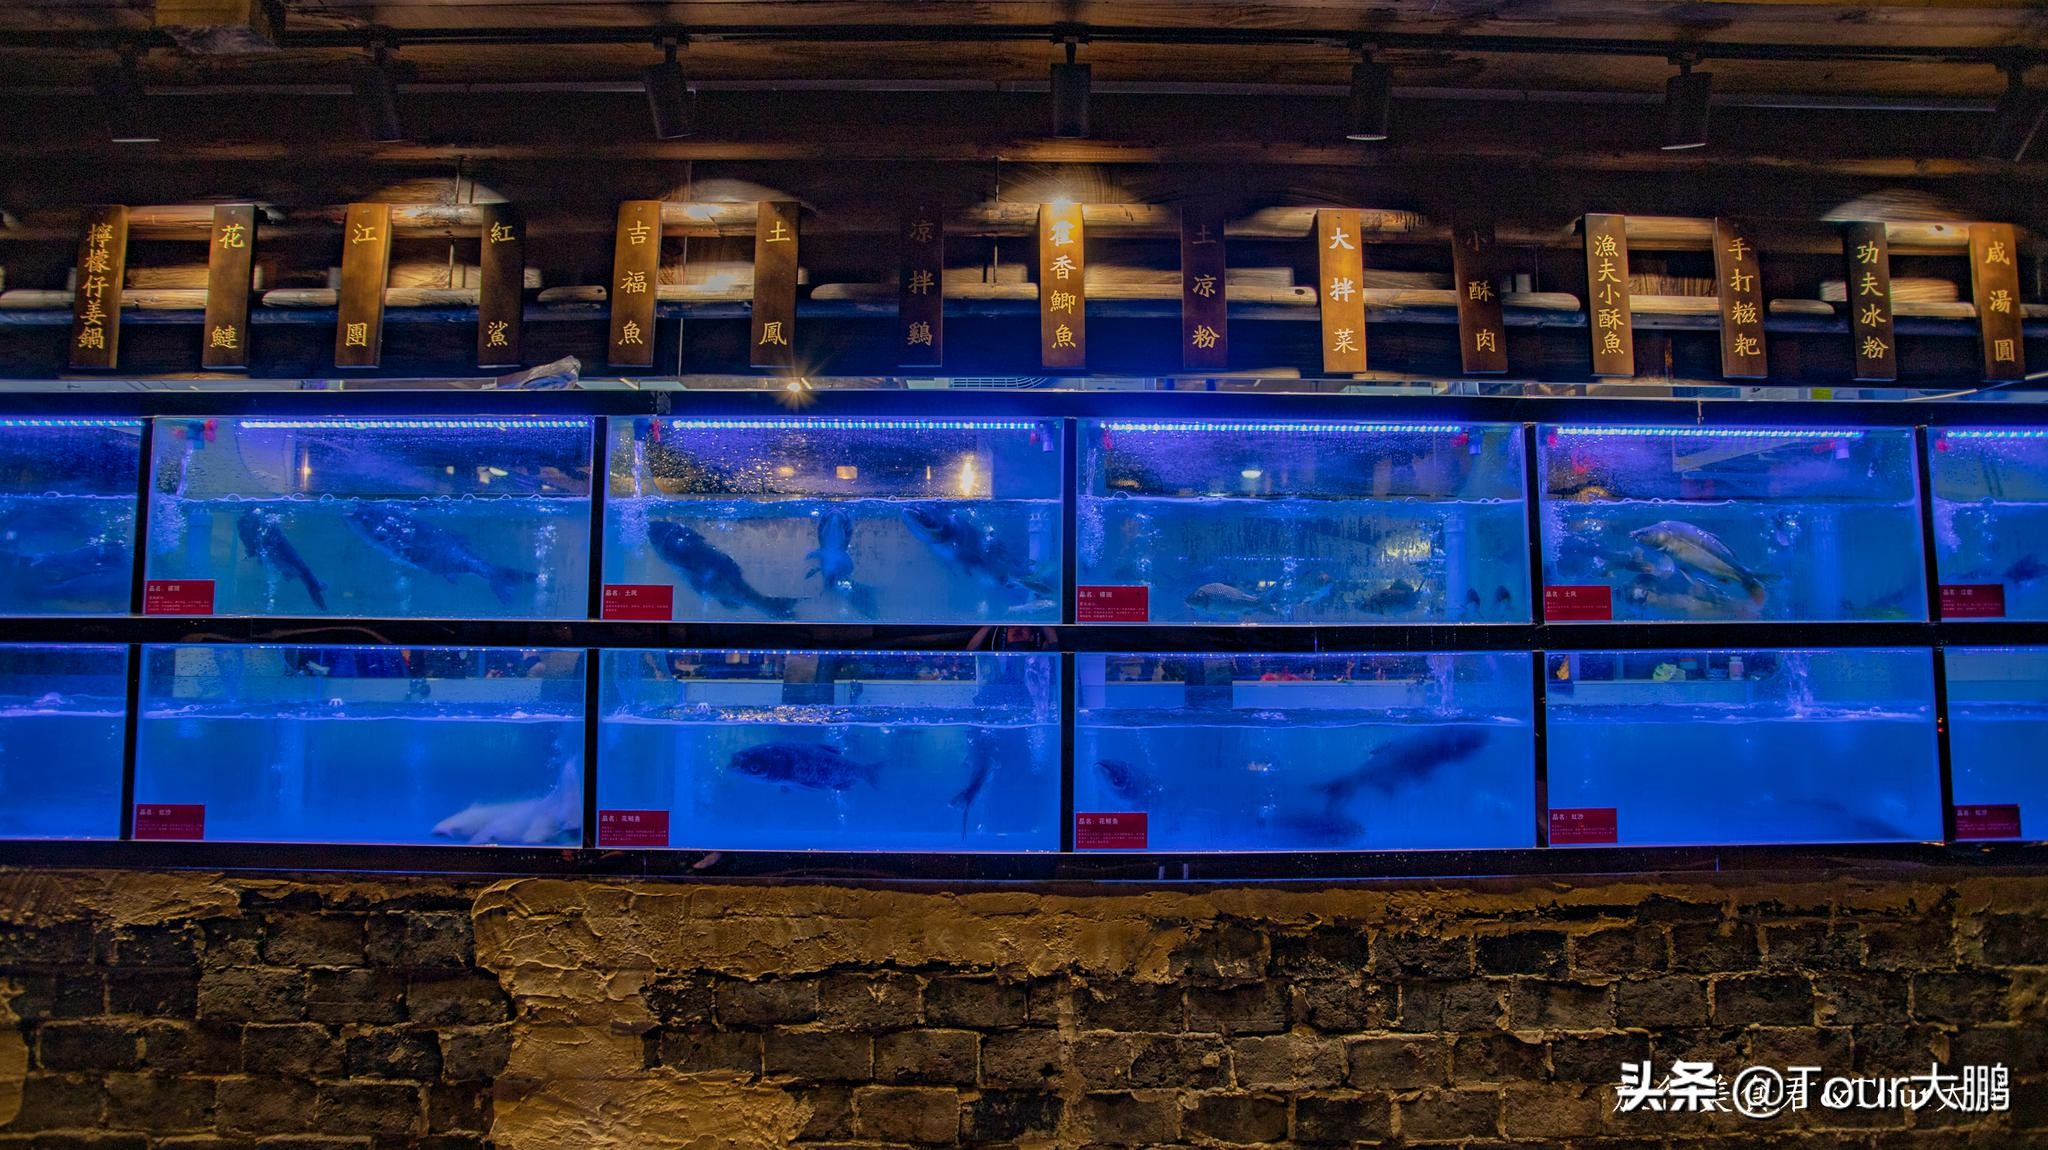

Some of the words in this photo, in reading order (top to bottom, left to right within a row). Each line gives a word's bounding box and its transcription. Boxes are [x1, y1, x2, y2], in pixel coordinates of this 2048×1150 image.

[487, 221, 516, 348] 紅鯊
[618, 220, 651, 346] 吉福魚
[758, 221, 792, 346] 土鳳
[1329, 227, 1359, 354] 大拌菜
[1467, 229, 1497, 353] 小酥肉
[1594, 234, 1625, 355] 漁夫小酥魚
[1727, 236, 1761, 357] 手打糍粑
[1856, 240, 1889, 359] 功夫冰粉
